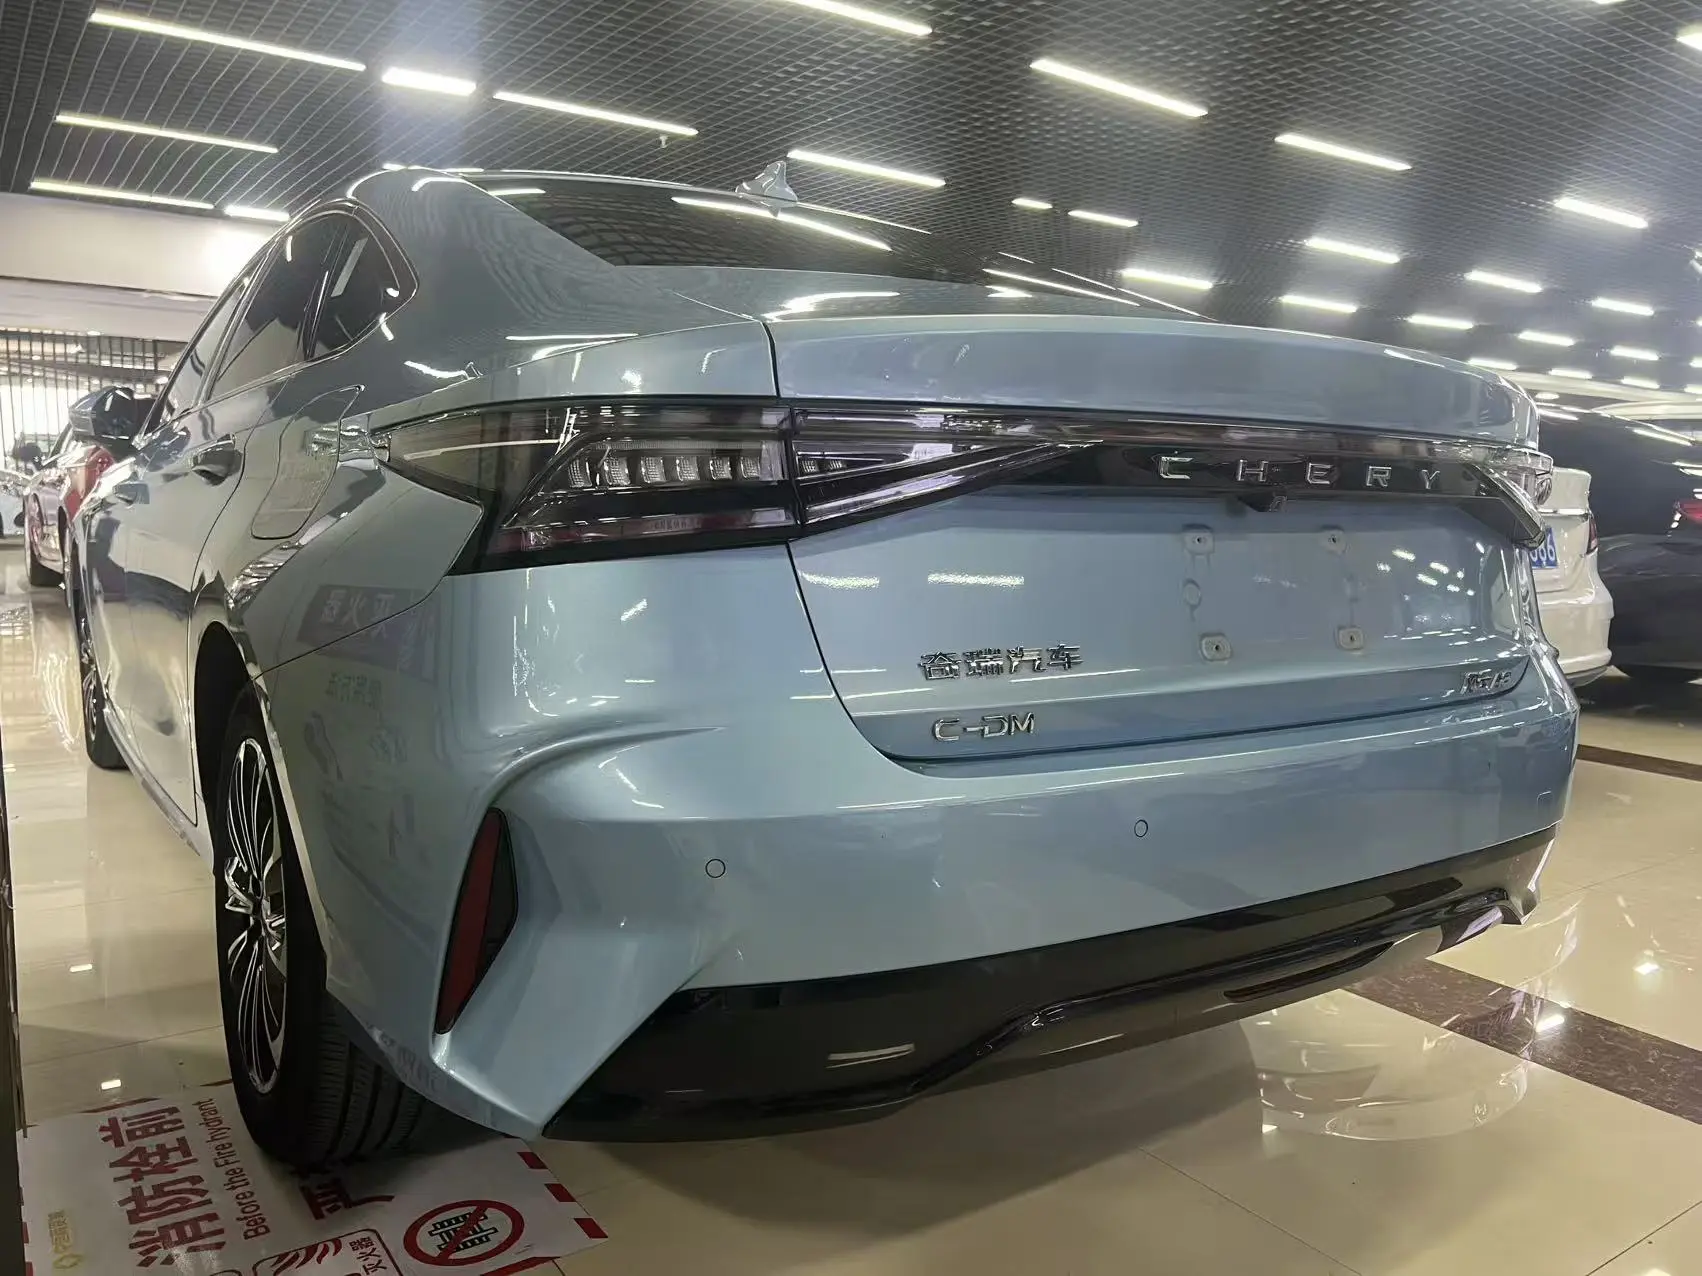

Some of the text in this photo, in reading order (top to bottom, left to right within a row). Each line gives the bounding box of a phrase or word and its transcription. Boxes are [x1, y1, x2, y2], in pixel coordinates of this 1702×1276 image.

[1158, 454, 1441, 490] CHERY
[919, 643, 1084, 680] 奇瑞汽车
[933, 712, 1035, 741] C-DM
[98, 1106, 227, 1267] 消防栓前
[192, 1098, 271, 1240] Before the Fire hydrant
[348, 1236, 388, 1276] 灭火器
